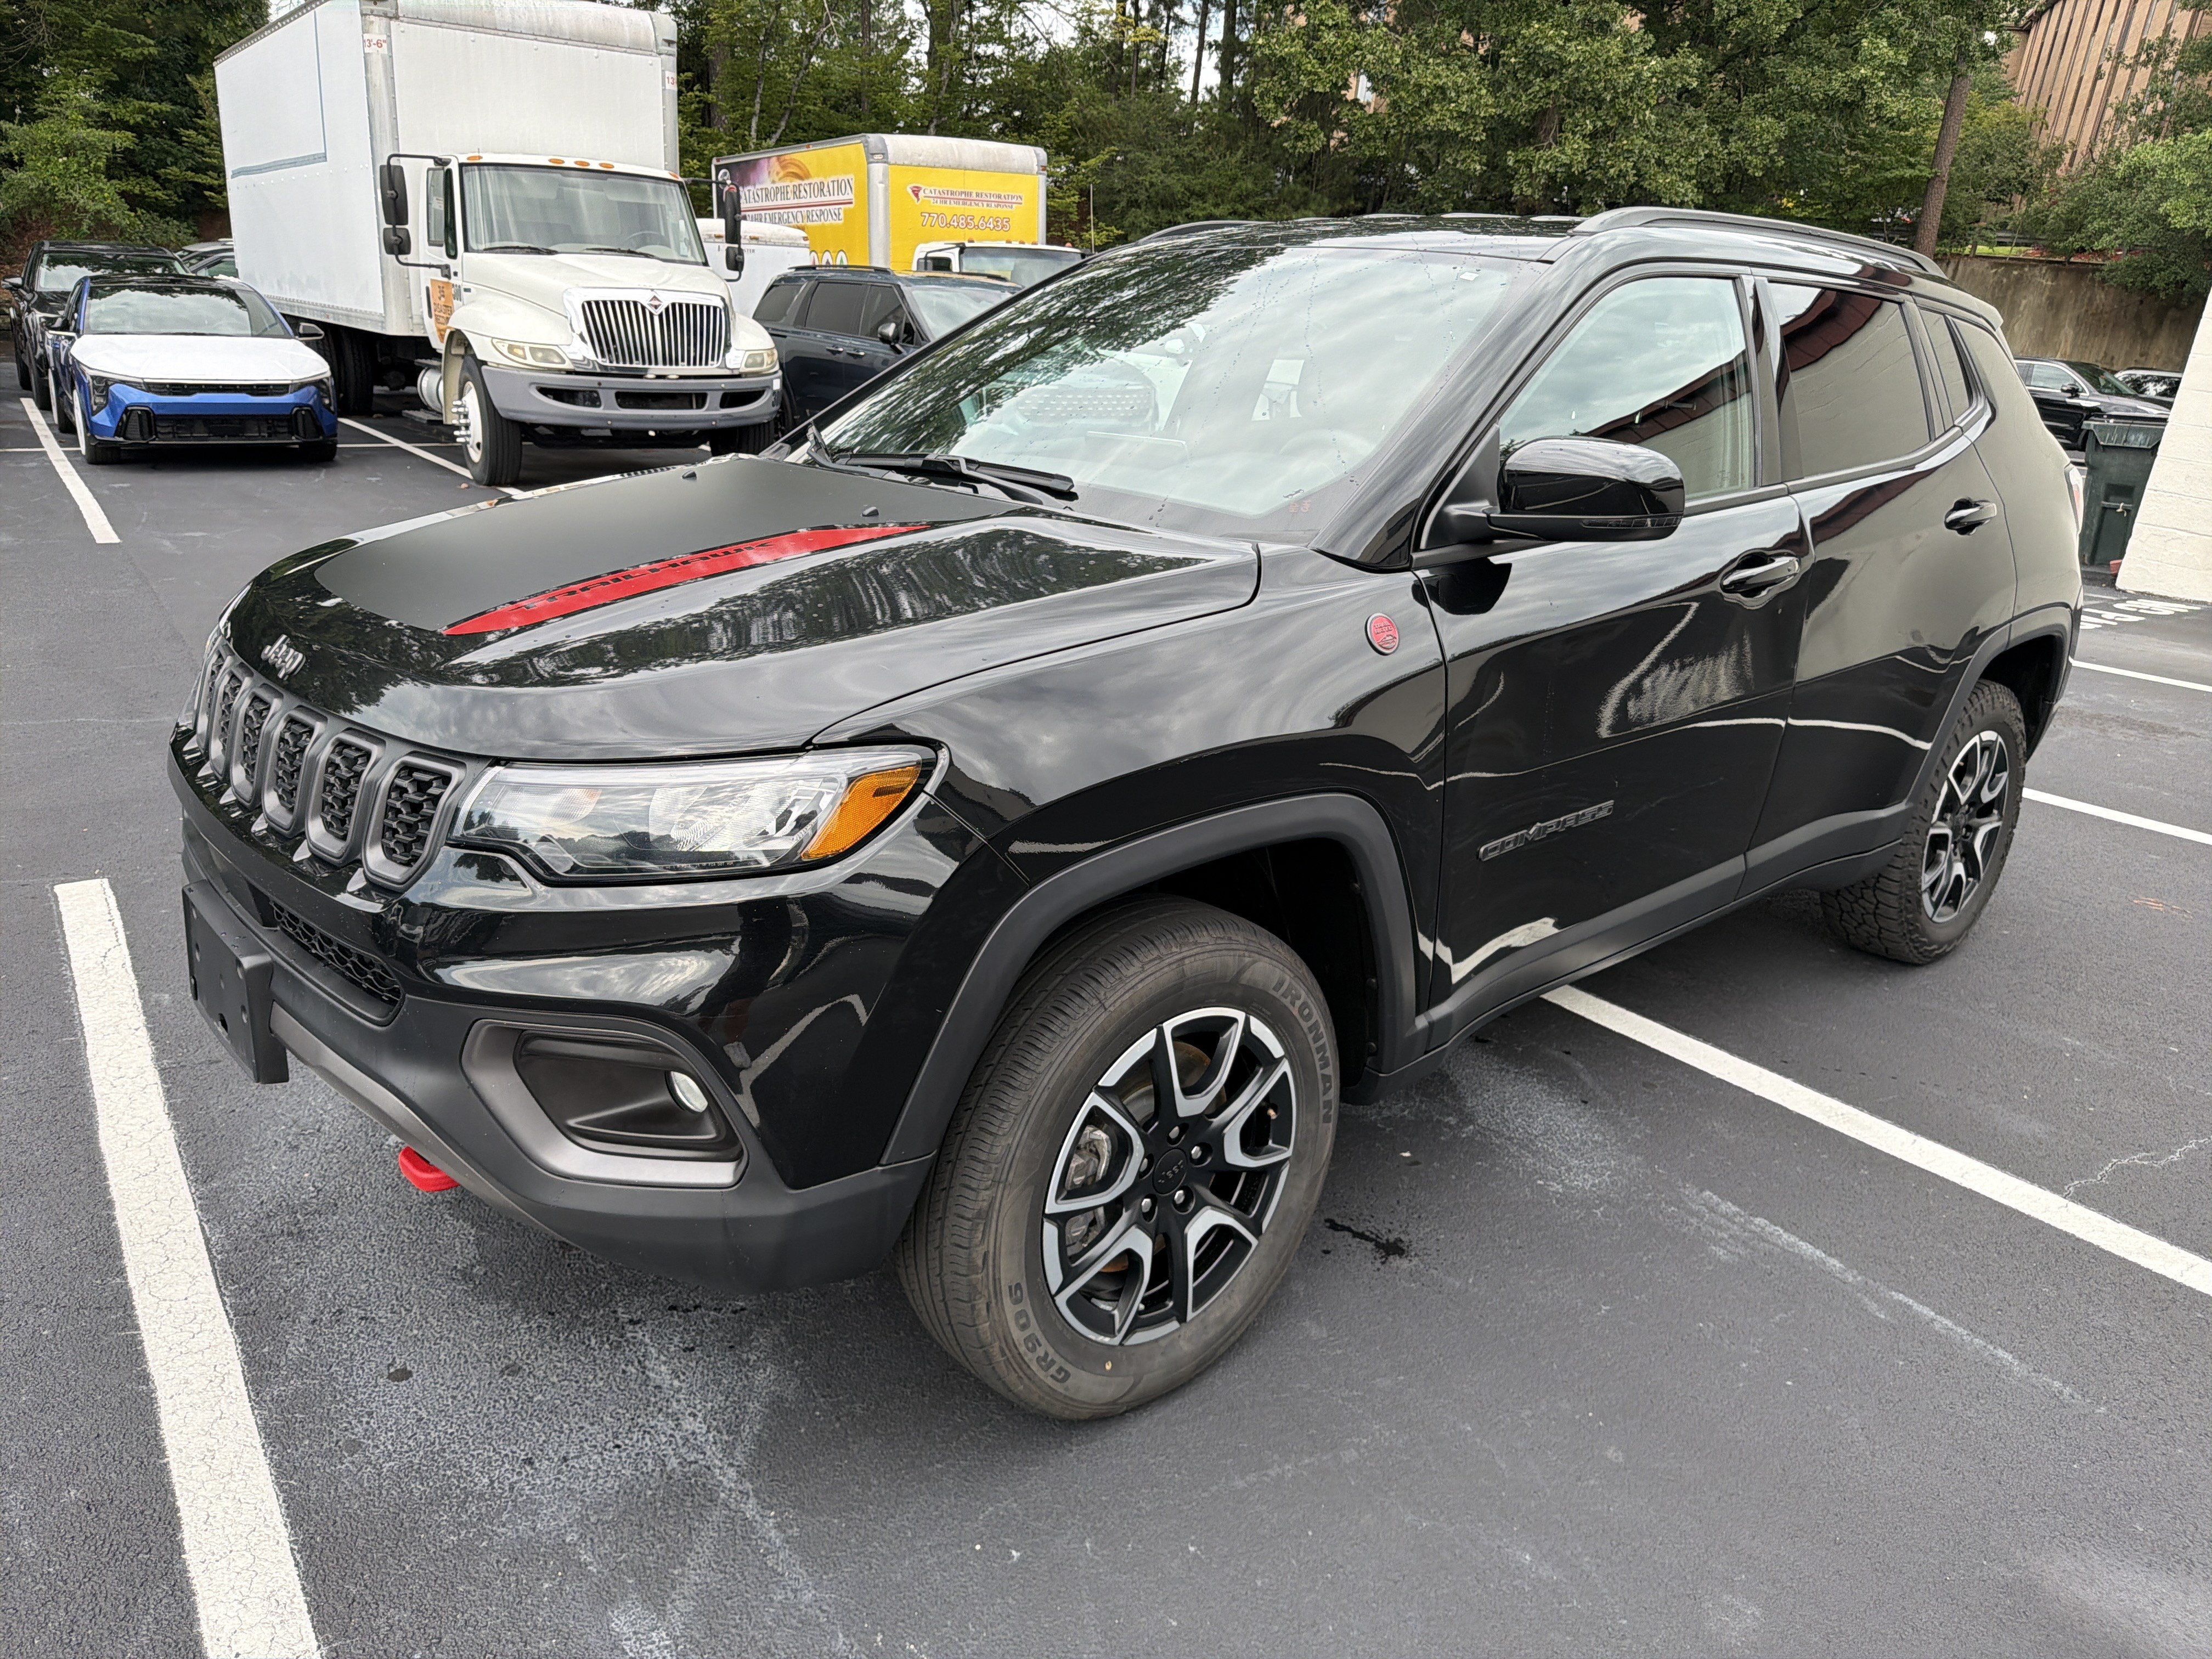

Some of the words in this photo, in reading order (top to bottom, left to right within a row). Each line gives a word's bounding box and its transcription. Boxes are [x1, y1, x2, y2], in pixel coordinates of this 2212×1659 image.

[741, 184, 791, 204] ATASTROPHE
[793, 178, 853, 200] RESTORATION
[923, 188, 974, 198] CATASTROPHE
[975, 191, 1023, 201] RESTORATION
[949, 200, 984, 208] EMERGENCY
[806, 207, 842, 223] RESPONSE
[921, 212, 1011, 232] 770.485.6435
[509, 541, 775, 611] TRAILHAWK
[261, 634, 306, 680] Jeep
[1478, 800, 1615, 861] COMPASS
[1272, 976, 1333, 1124] IRONMAN
[1008, 1282, 1071, 1384] GR906
